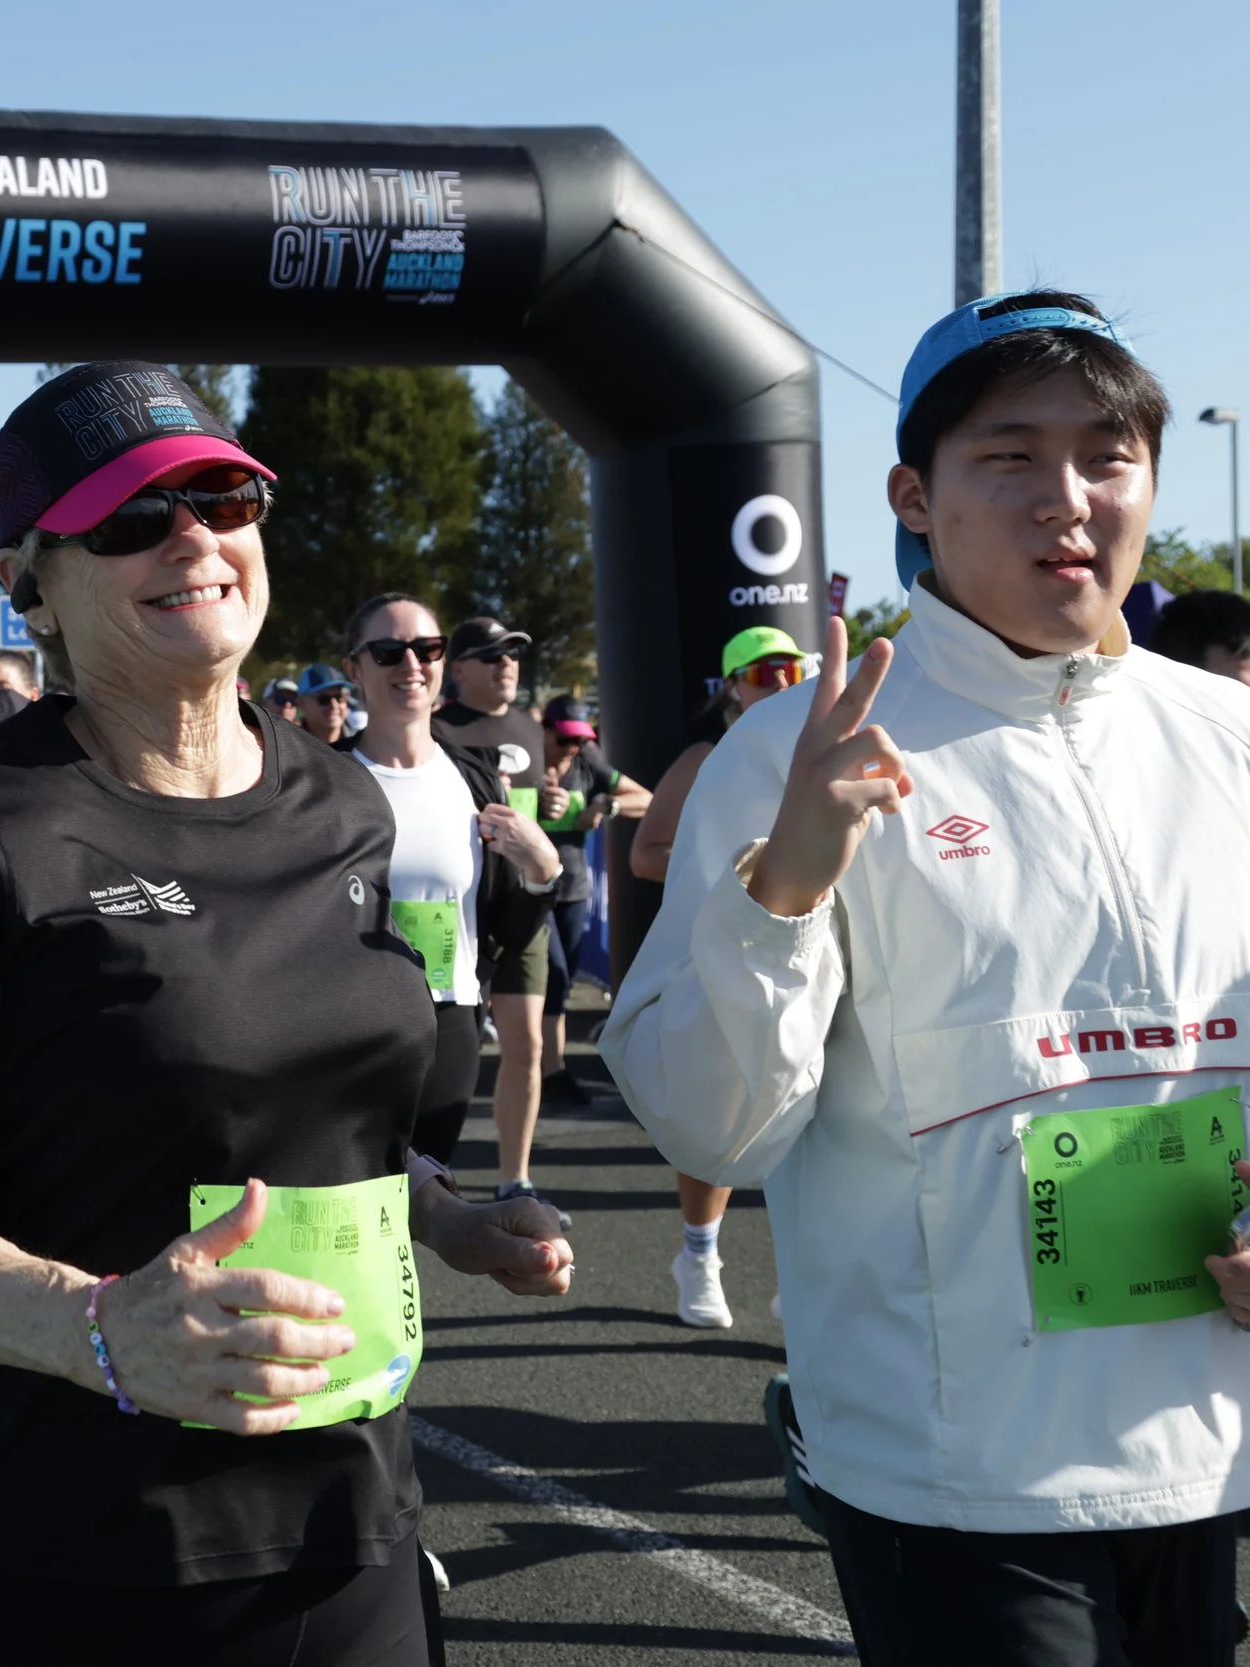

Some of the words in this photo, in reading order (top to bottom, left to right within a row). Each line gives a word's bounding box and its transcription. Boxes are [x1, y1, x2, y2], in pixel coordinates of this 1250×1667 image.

[268, 165, 370, 226] RUN
[368, 168, 467, 229] THE
[269, 226, 386, 290] CITY
[54, 378, 119, 432] RUN
[113, 371, 182, 400] THE
[75, 399, 148, 461] CITY
[729, 583, 809, 606] one.nz
[938, 844, 991, 861] umbro
[90, 890, 107, 899] New
[107, 883, 138, 896] Zealand
[98, 899, 147, 913] Sotheby's
[291, 1226, 334, 1253] CITY
[1033, 1178, 1061, 1265] 34143
[397, 1244, 417, 1341] 34792
